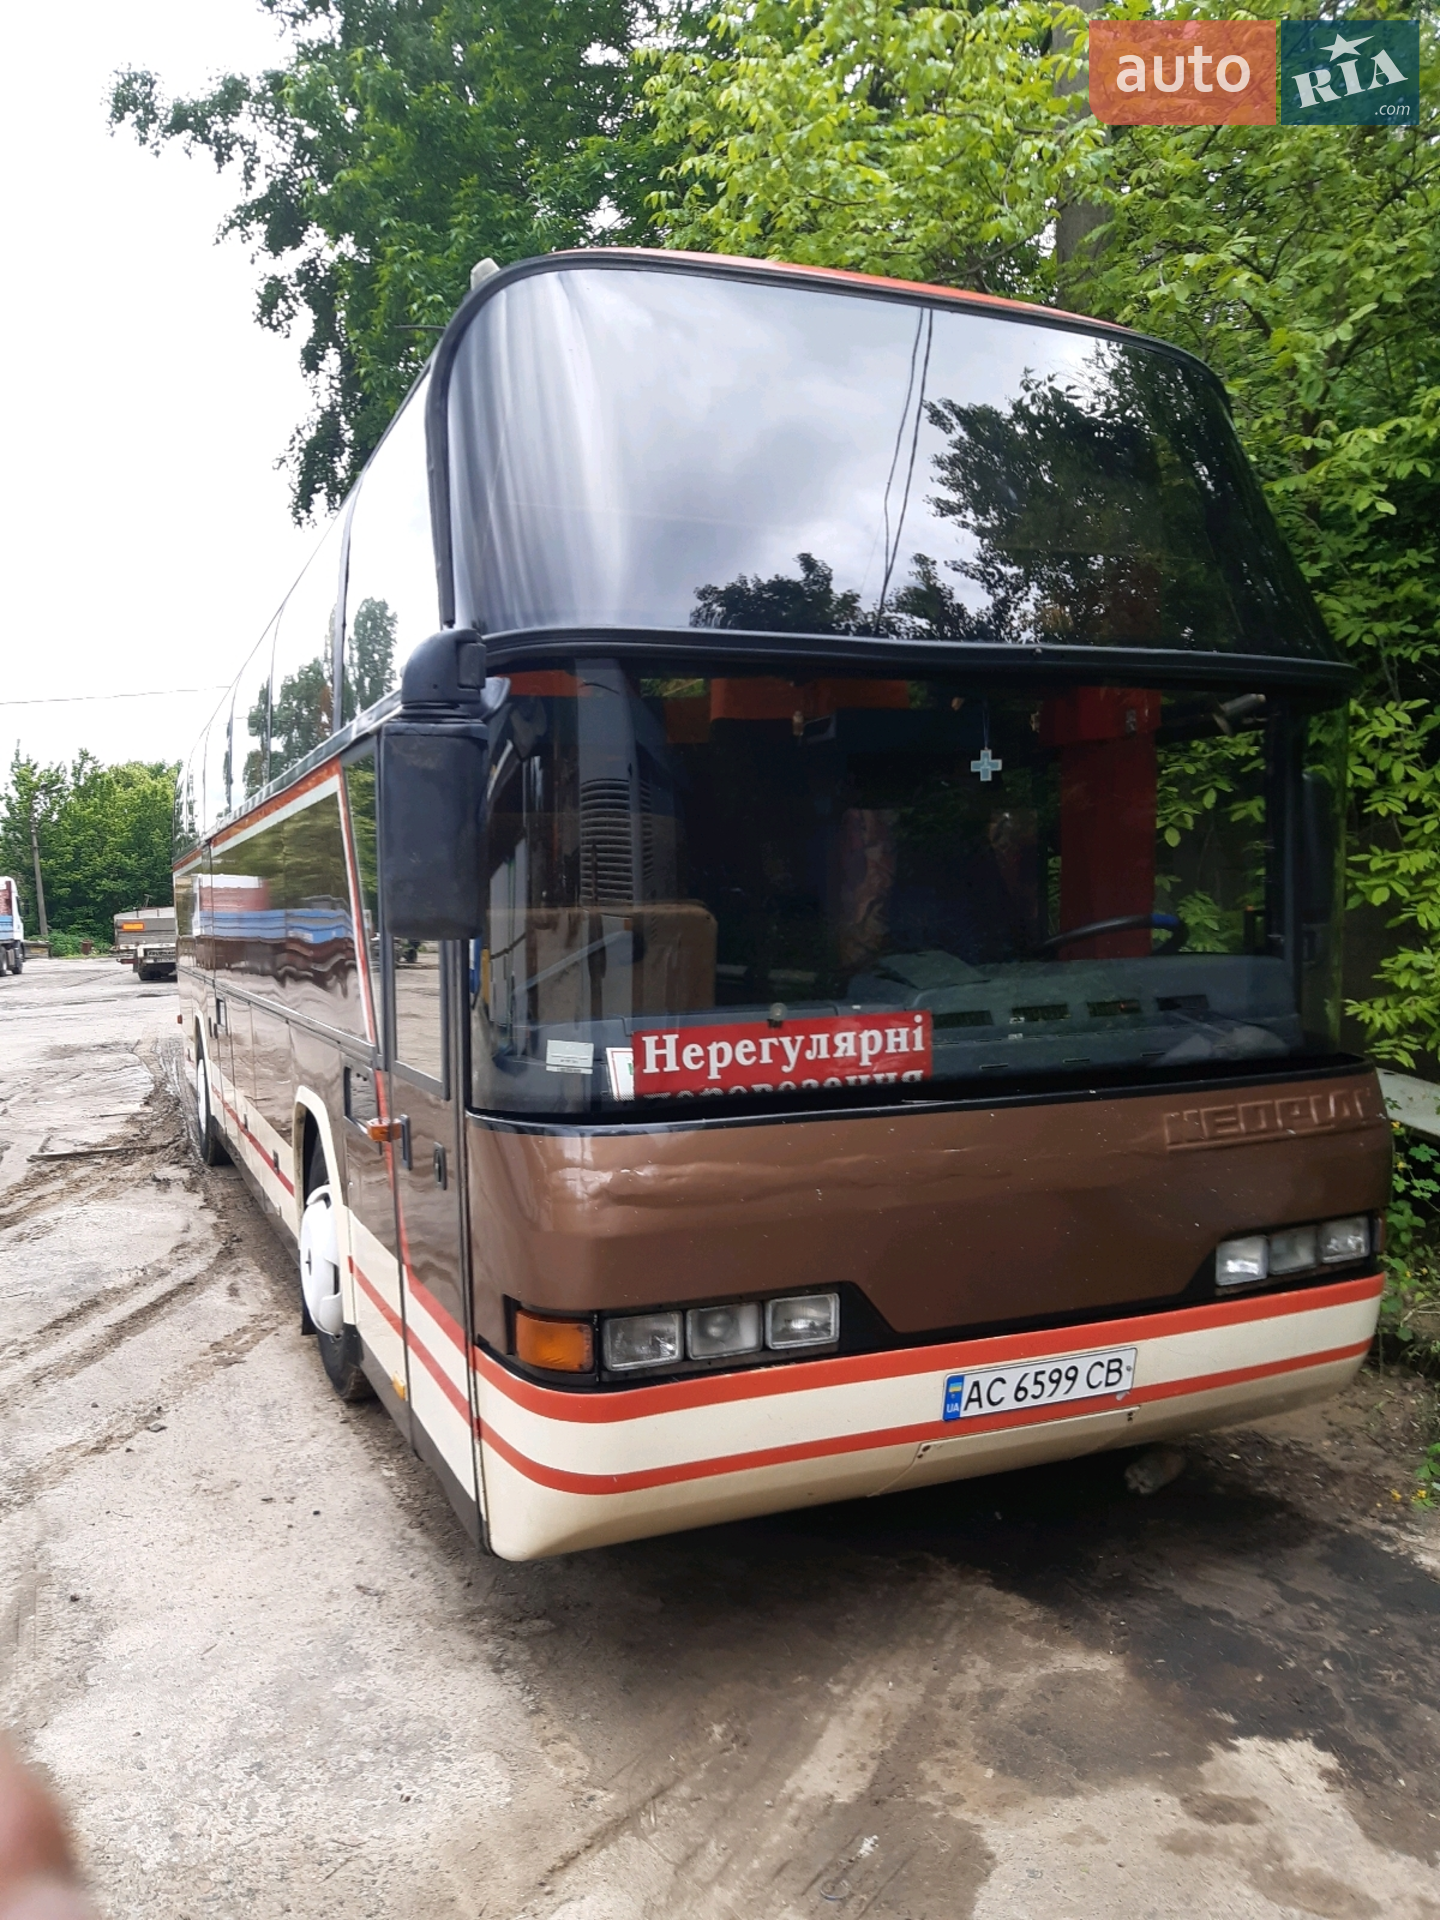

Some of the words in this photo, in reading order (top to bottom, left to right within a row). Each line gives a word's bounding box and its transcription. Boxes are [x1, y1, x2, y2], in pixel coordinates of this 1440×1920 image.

[642, 1014, 925, 1079] Нерегулярні
[946, 1402, 960, 1413] UA
[963, 1377, 1007, 1411] AC
[1013, 1365, 1079, 1403] 6599
[1086, 1358, 1123, 1389] CB
